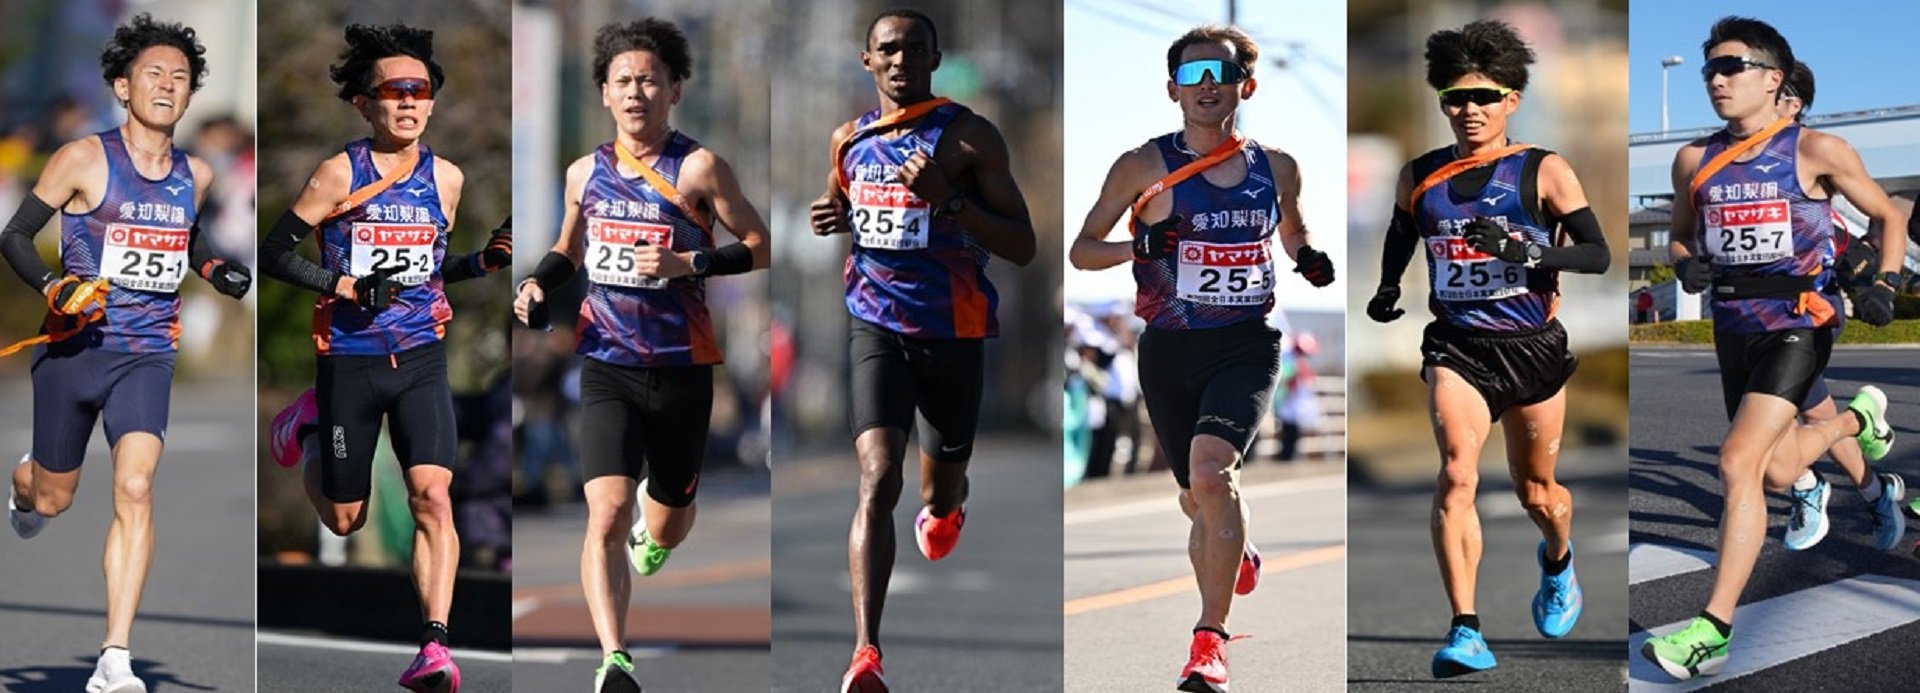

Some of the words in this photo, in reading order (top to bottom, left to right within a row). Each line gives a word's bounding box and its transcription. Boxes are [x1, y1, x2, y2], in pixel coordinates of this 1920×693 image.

[855, 208, 920, 236] 25-4
[1720, 228, 1784, 252] 25-7
[120, 250, 182, 278] 25-1
[370, 248, 429, 273] 25-2
[1198, 268, 1271, 293] 25-5
[1447, 262, 1518, 287] 25-6
